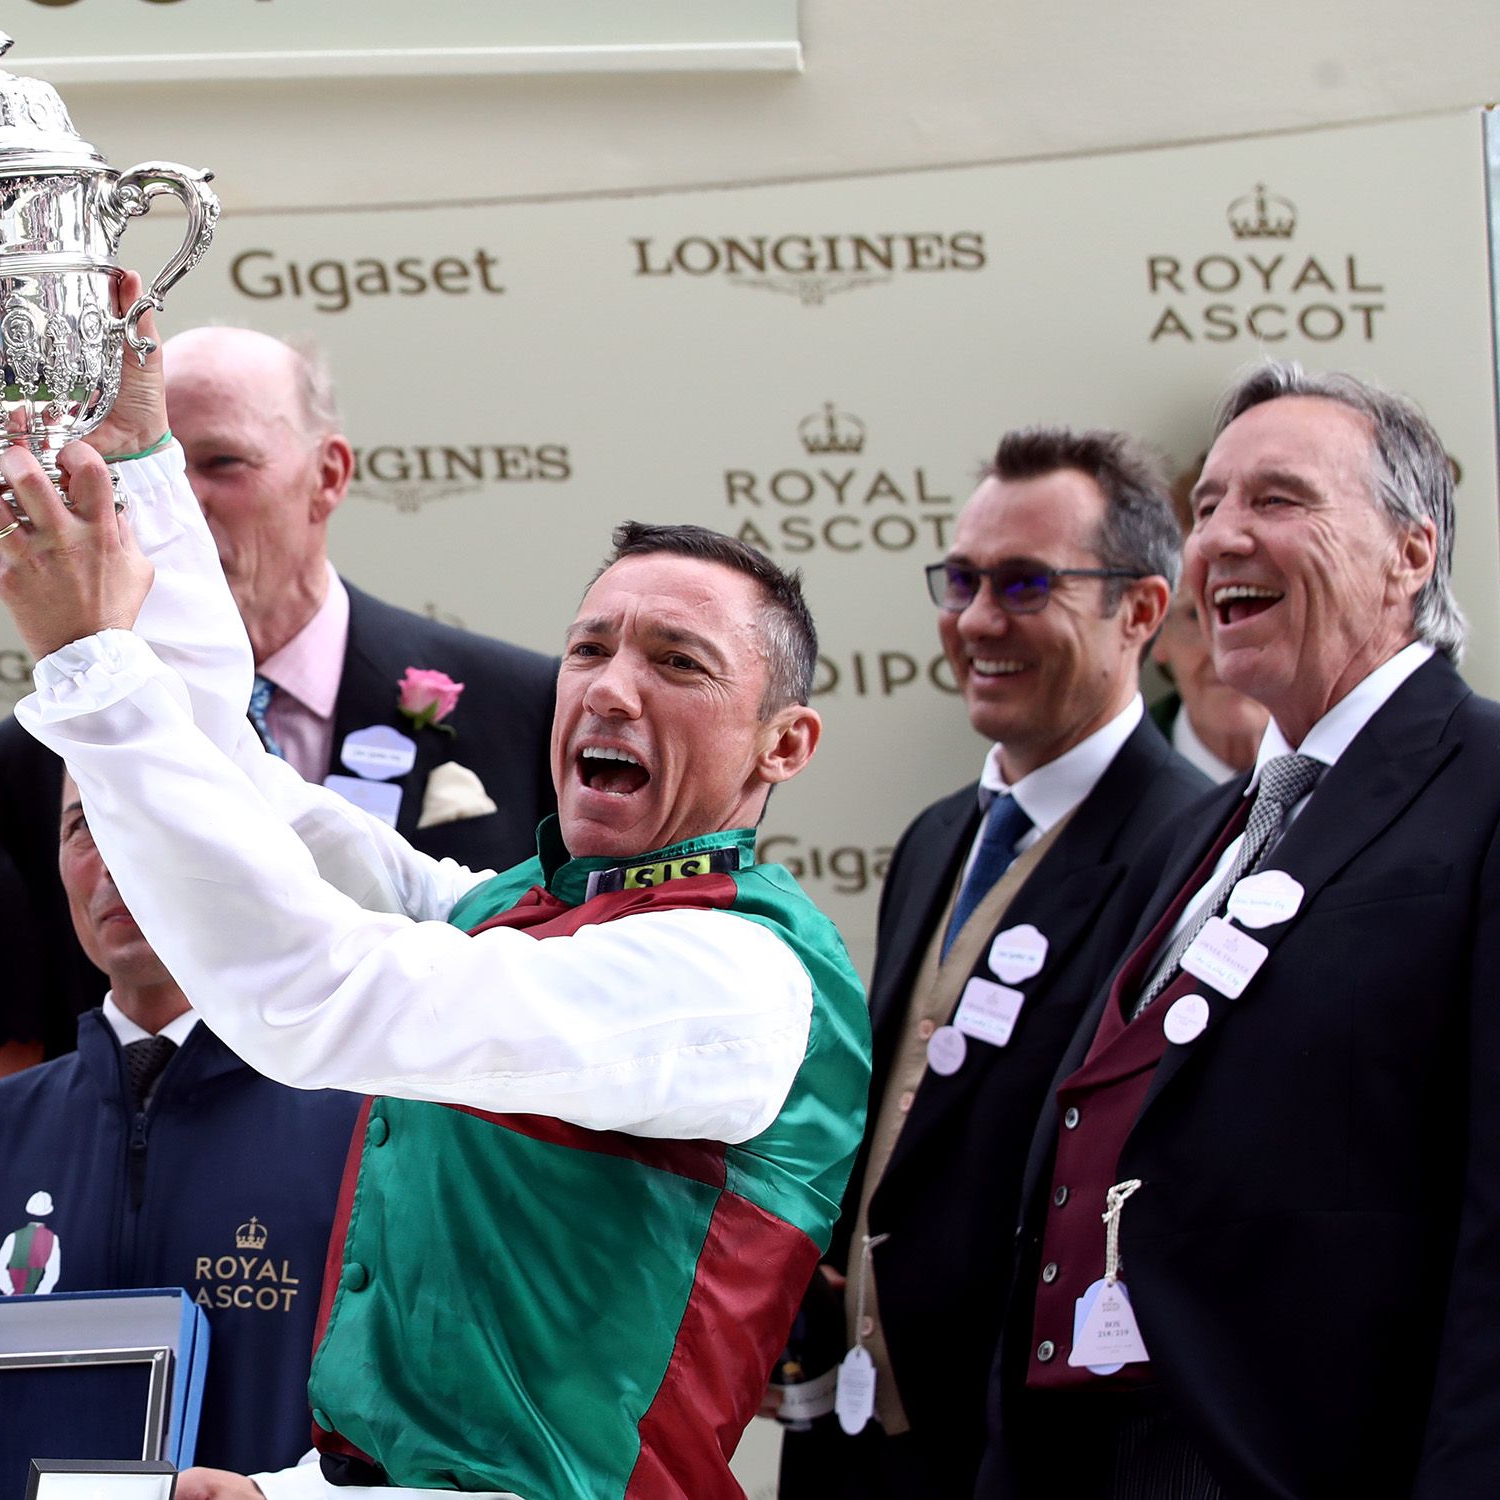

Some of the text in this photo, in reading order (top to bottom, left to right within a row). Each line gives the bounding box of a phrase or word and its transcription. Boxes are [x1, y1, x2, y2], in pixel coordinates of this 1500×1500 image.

[630, 232, 987, 277] LONGINES
[1147, 254, 1384, 294] ROYAL
[230, 247, 505, 313] Gigaset
[1149, 303, 1385, 342] ASCOT
[724, 467, 952, 507] ROYAL
[737, 514, 954, 552] ASCOT
[634, 860, 701, 888] SIS
[195, 1256, 300, 1284] ROYAL
[195, 1284, 298, 1312] ASCOT
